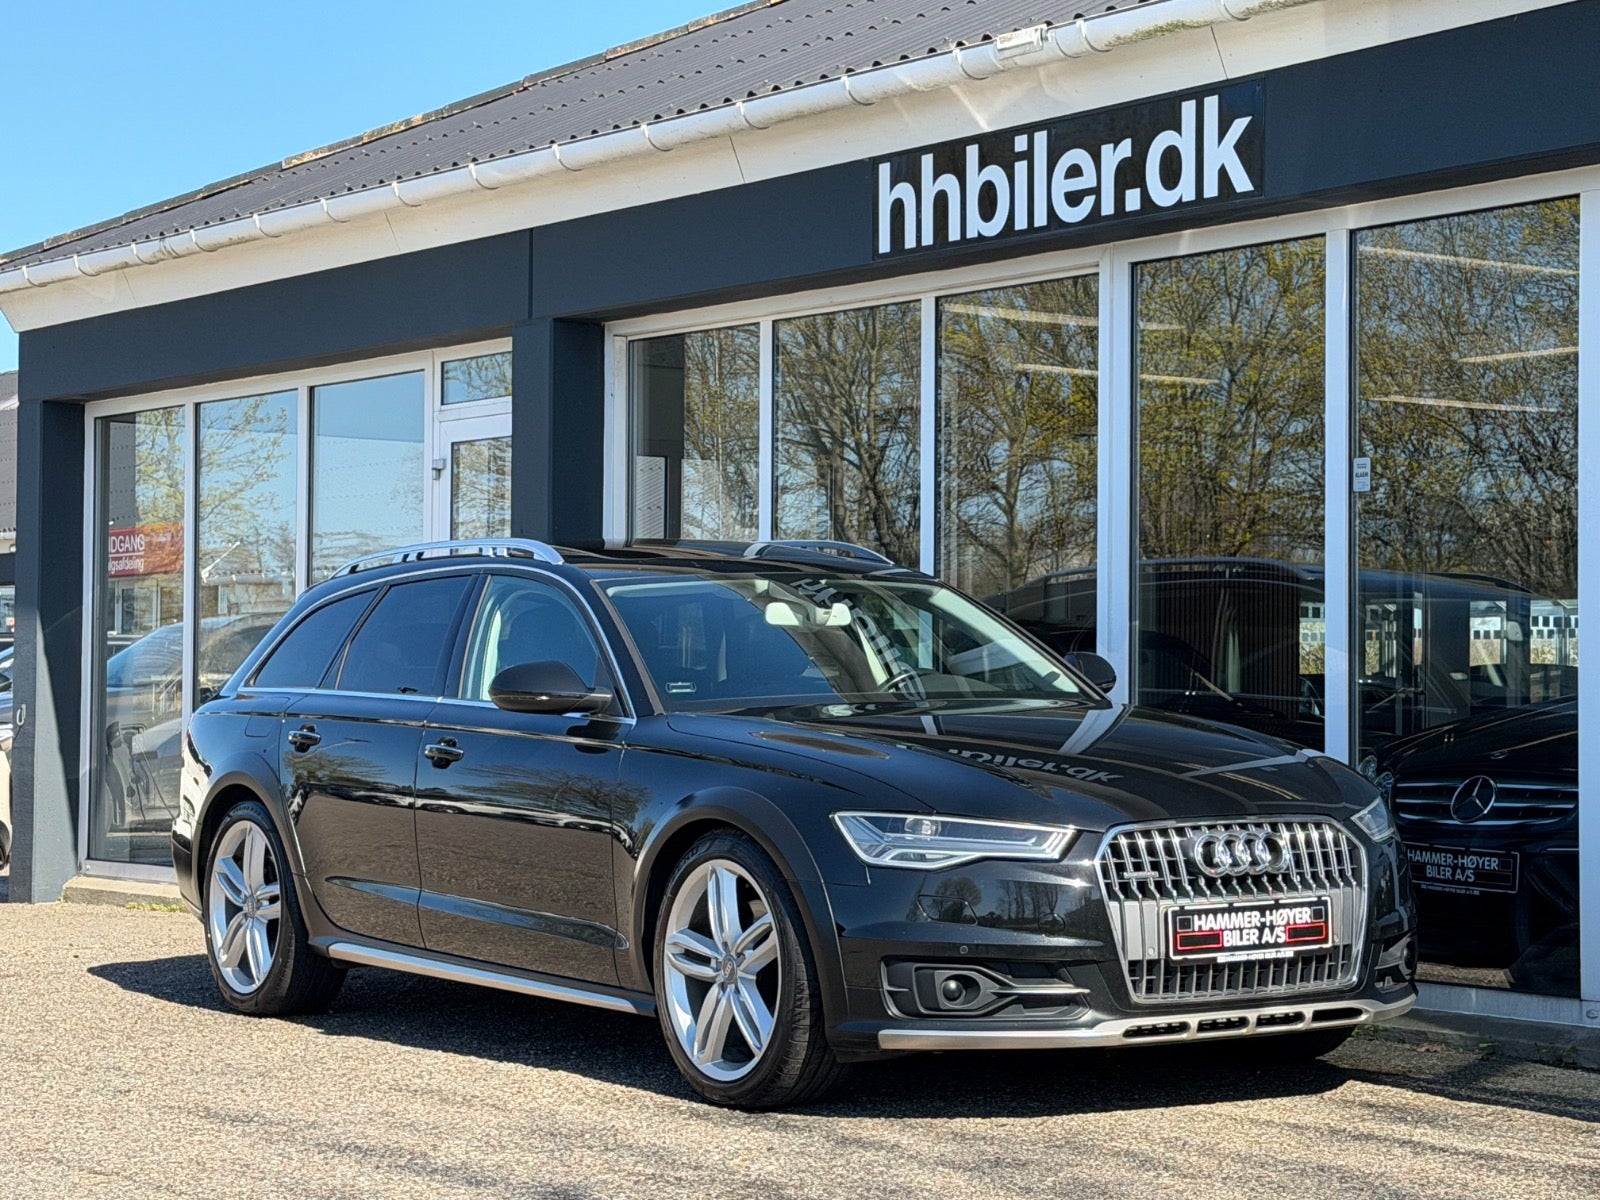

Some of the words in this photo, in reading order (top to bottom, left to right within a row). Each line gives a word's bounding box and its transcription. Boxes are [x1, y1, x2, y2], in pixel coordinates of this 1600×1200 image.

[878, 94, 1255, 254] hhbiler.dk
[1407, 848, 1499, 871] HAMMER-HØYER
[1426, 864, 1452, 880] BILER
[1454, 868, 1475, 882] A/S
[1193, 906, 1311, 932] HAMMER-HØYER
[1223, 927, 1259, 948] BILER
[1261, 925, 1286, 943] A/S
